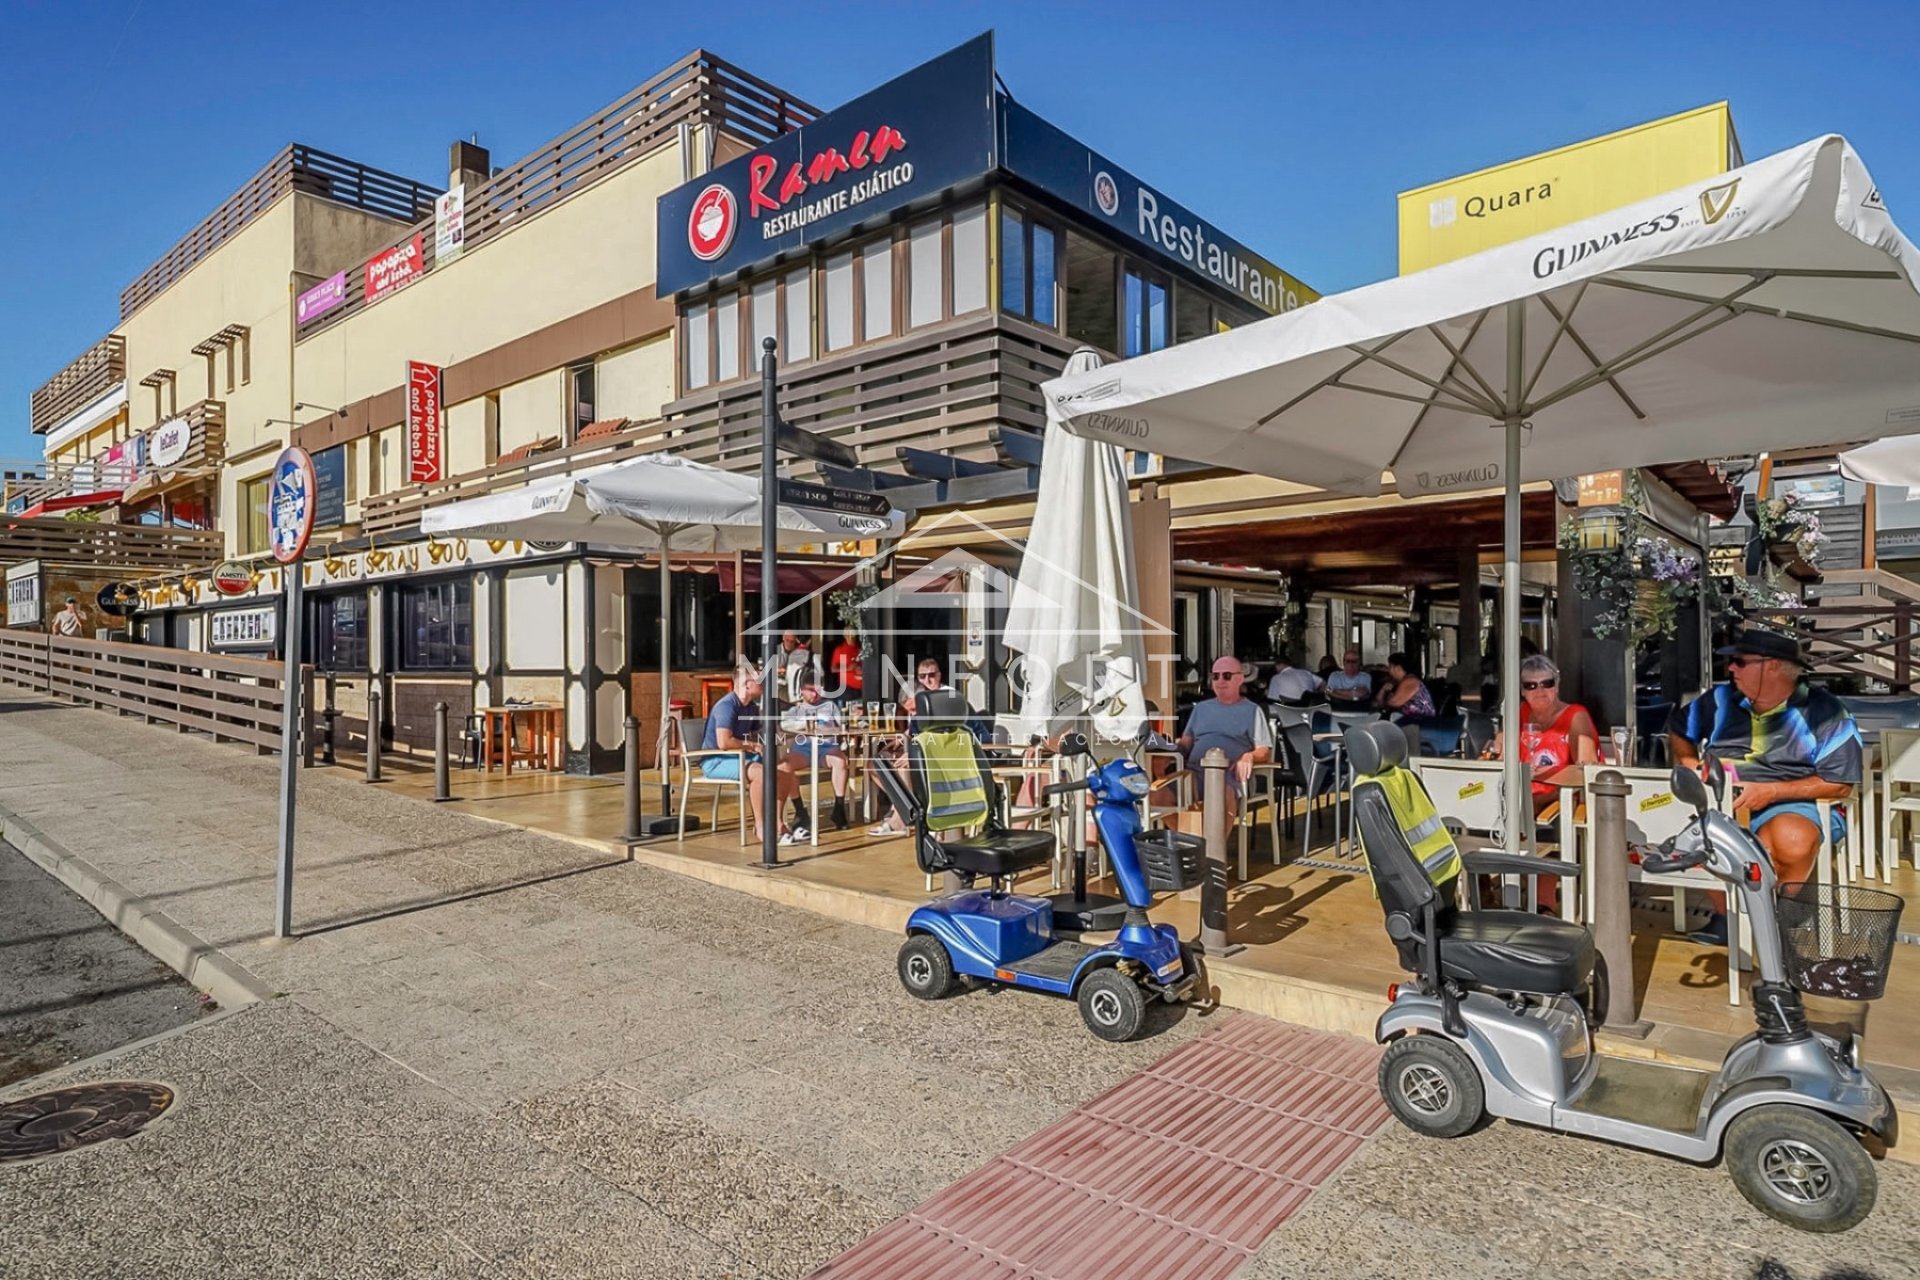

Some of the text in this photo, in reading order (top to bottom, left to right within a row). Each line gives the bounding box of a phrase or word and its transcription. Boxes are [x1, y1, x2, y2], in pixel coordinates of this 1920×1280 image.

[750, 125, 907, 218] Ramen
[763, 162, 913, 240] RESTAURANTE ASIÁTICO
[1464, 183, 1552, 218] Quara
[1137, 187, 1298, 313] Restaurante
[1532, 205, 1686, 280] GUINNESS
[411, 387, 423, 458] and kebab
[838, 514, 882, 530] GUINNESS
